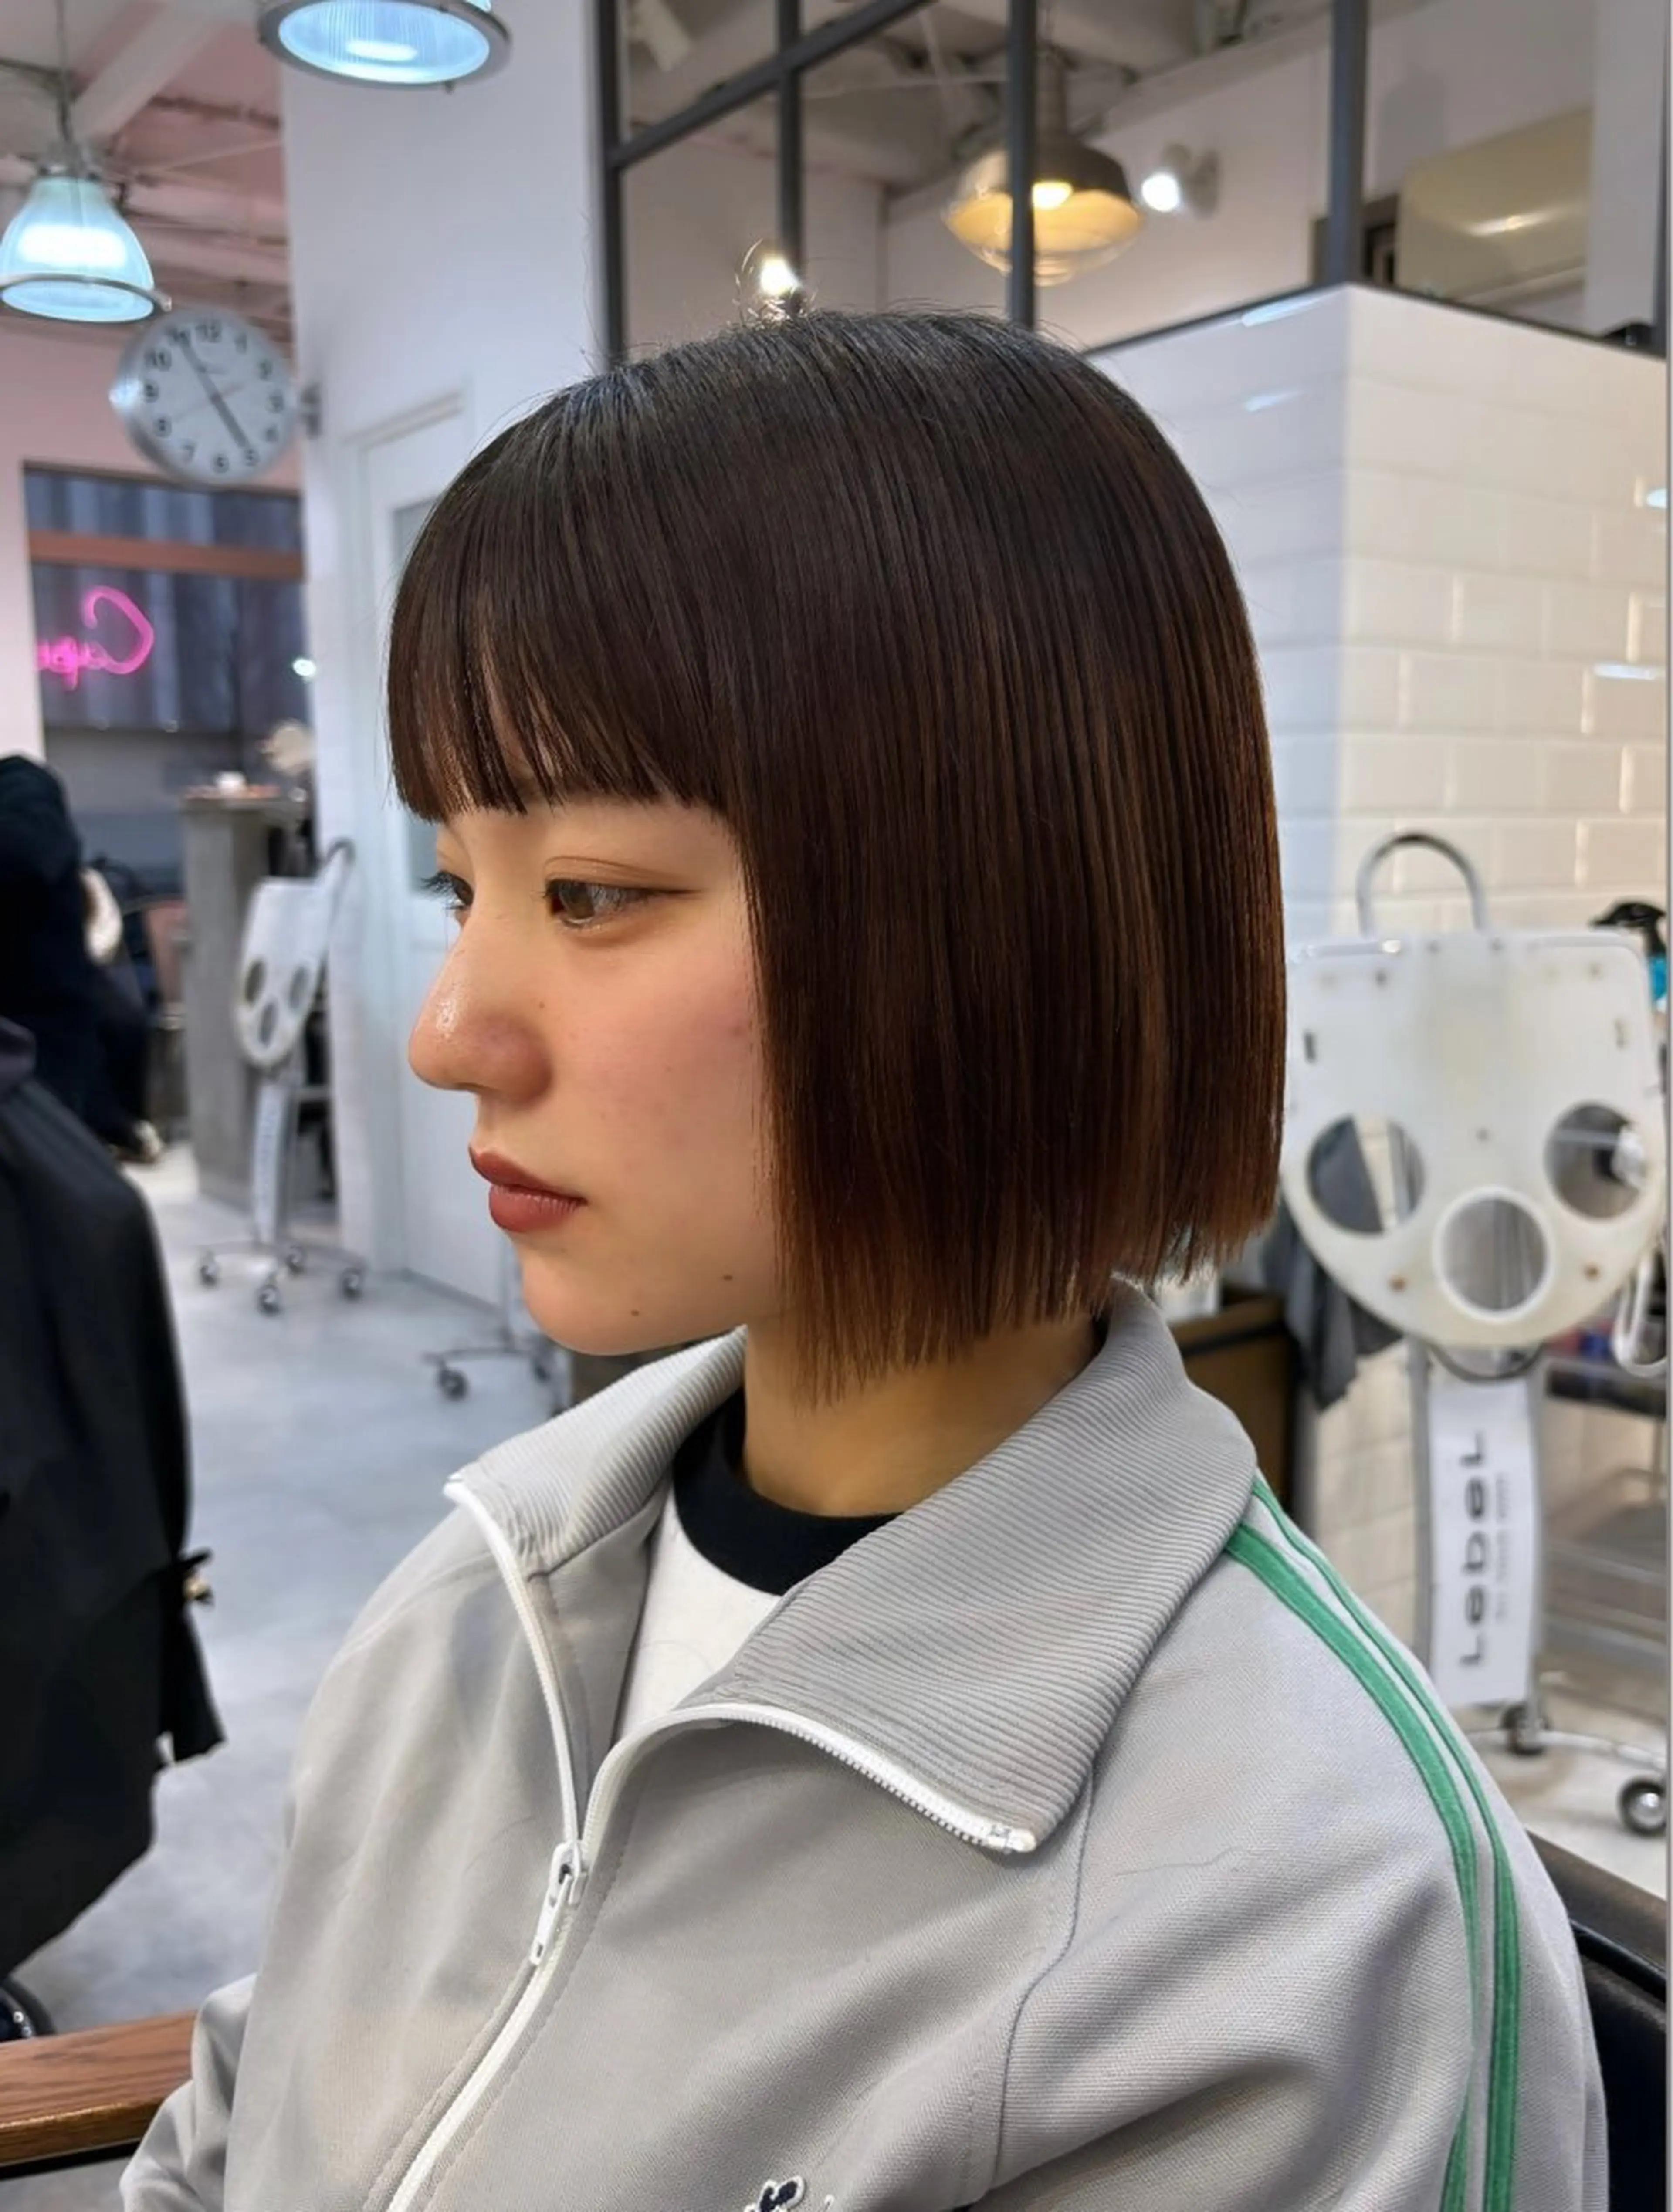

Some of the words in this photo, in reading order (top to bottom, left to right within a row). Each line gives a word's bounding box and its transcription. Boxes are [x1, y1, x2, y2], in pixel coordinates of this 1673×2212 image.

[196, 320, 221, 343] 12
[234, 333, 247, 353] 1
[145, 348, 171, 370] 10
[143, 381, 158, 402] 9
[180, 440, 195, 462] 7
[243, 447, 258, 467] 5
[213, 453, 229, 473] 6
